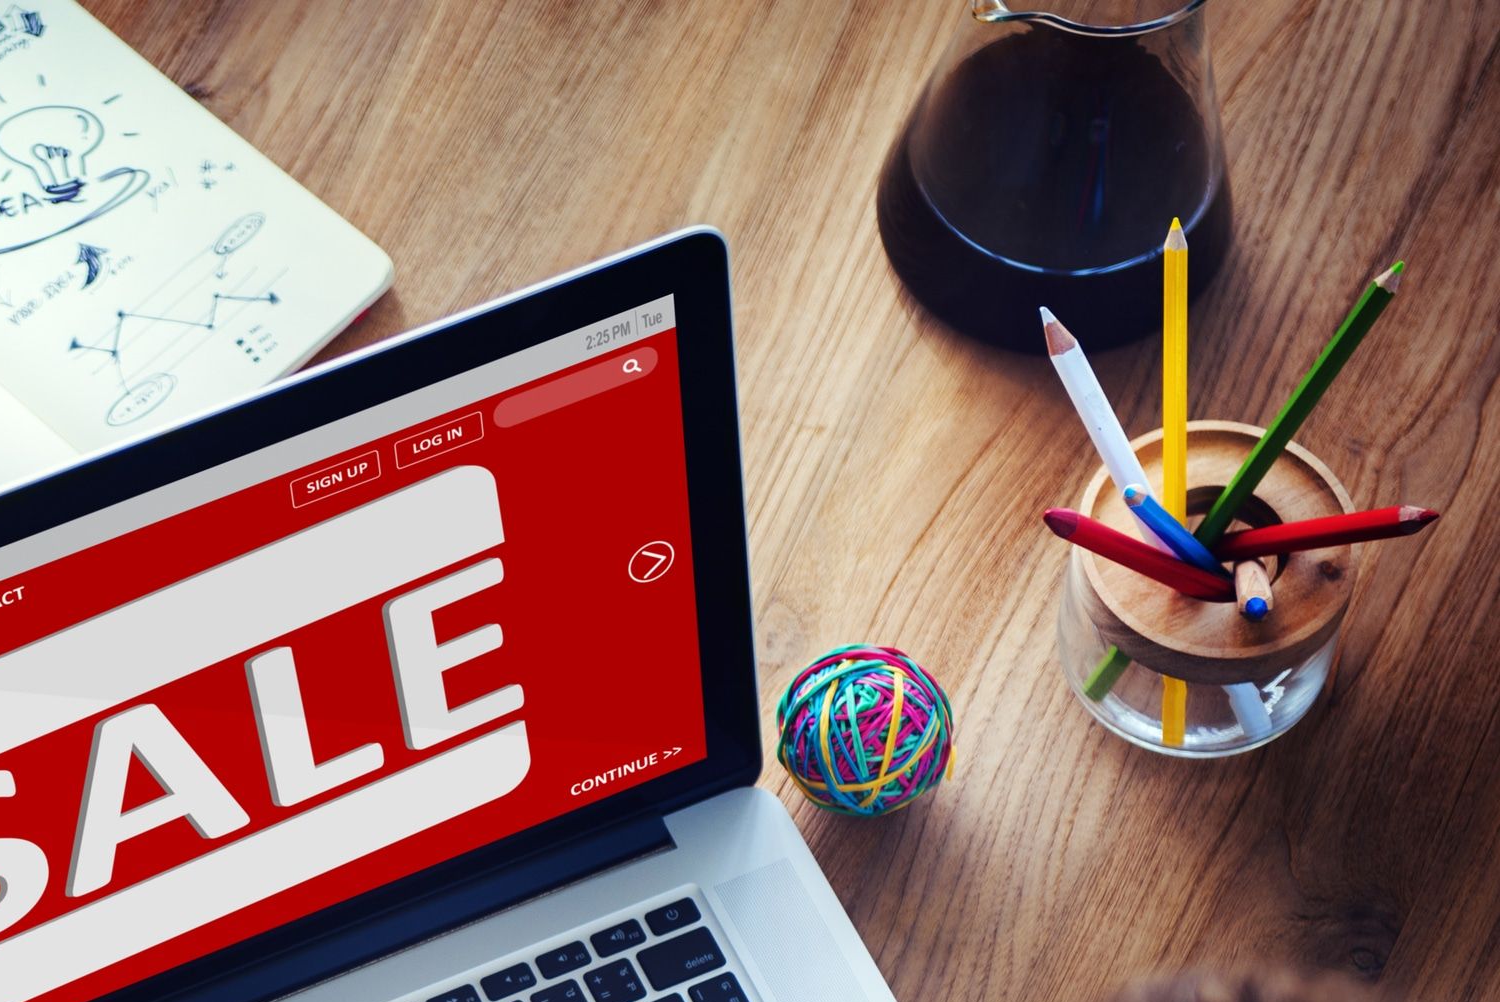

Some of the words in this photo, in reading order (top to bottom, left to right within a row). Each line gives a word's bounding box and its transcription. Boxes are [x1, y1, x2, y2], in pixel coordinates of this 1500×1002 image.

[585, 330, 610, 351] 2:25
[611, 321, 631, 342] PM
[642, 312, 663, 330] Tue
[411, 432, 445, 456] LOG
[447, 427, 462, 440] IN
[305, 468, 345, 496] SIGN
[346, 460, 370, 481] UP
[571, 753, 658, 795] CONTINUE
[686, 954, 716, 972] delete
